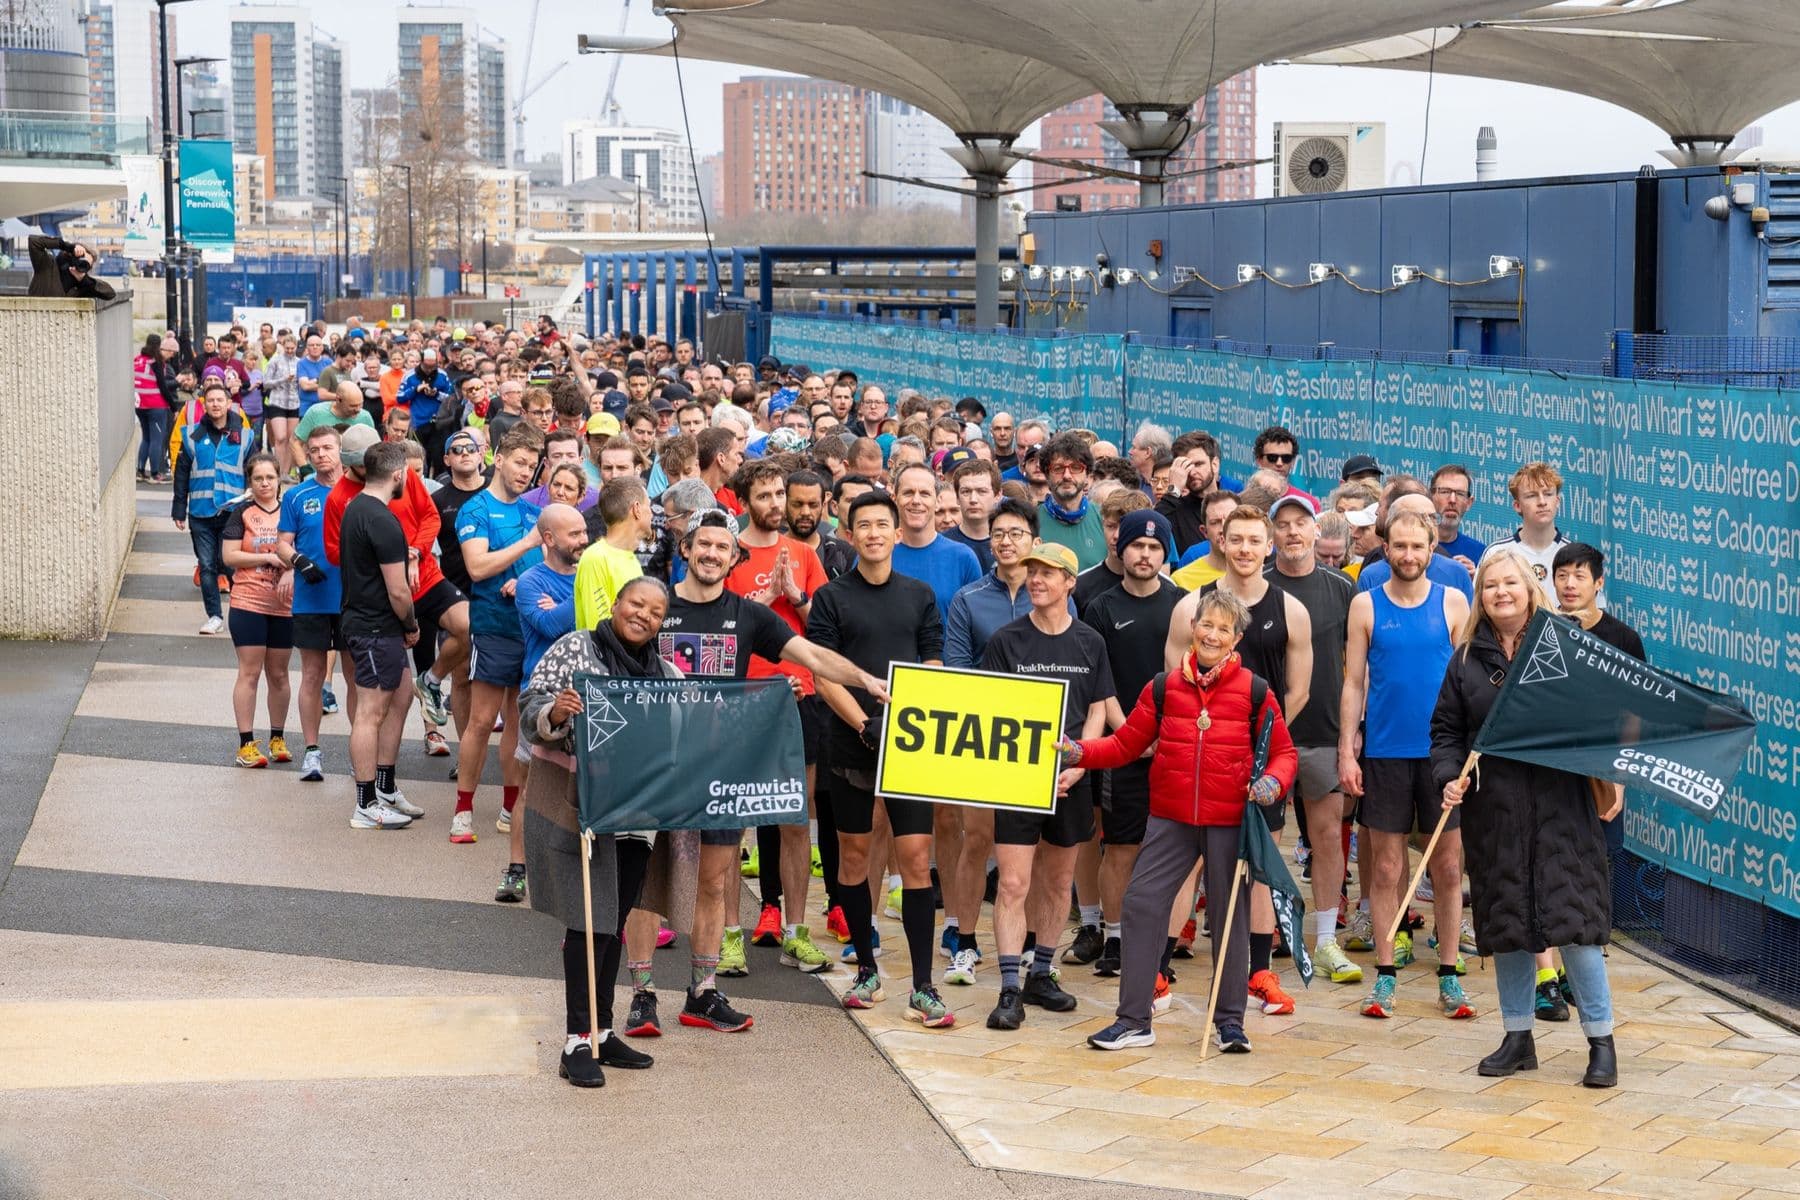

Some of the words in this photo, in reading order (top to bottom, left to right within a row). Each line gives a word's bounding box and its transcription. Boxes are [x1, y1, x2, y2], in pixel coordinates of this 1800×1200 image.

[183, 187, 232, 198] Greenwich
[186, 199, 229, 209] Peninsula
[188, 177, 226, 186] Discover
[1186, 357, 1228, 389] Docklands
[1299, 370, 1355, 400] asthouse
[1401, 373, 1467, 410] Greenwich
[1486, 379, 1519, 416] North
[1520, 382, 1591, 425] Greenwich
[1608, 391, 1642, 440] Royal
[1645, 394, 1692, 437] Wharf
[1720, 398, 1800, 448] Woolwic
[1171, 390, 1219, 422] Westminster
[1402, 416, 1448, 452] London
[1451, 420, 1493, 466] Bridge
[1510, 427, 1546, 465] Tower
[1566, 435, 1612, 486] Canary
[1612, 442, 1656, 484] Wharf
[1678, 450, 1782, 501] Doubletree
[1629, 495, 1689, 543] Chelsea
[1715, 507, 1800, 568] Cadogan
[1614, 542, 1676, 593] Bankside
[1702, 560, 1771, 612] London
[1671, 606, 1781, 669] Westminster
[624, 690, 724, 704] PENINSULA
[1575, 648, 1677, 702] PENINSULA
[895, 706, 1052, 765] START
[708, 777, 803, 797] Greenwich
[1612, 758, 1650, 777] Get
[1651, 769, 1716, 808] Active
[1620, 748, 1725, 795] Greenwich
[705, 801, 735, 816] Get
[738, 797, 801, 814] Active
[1714, 786, 1797, 842] sthouse
[1623, 797, 1677, 858] lantation
[1681, 821, 1736, 878] Wharf
